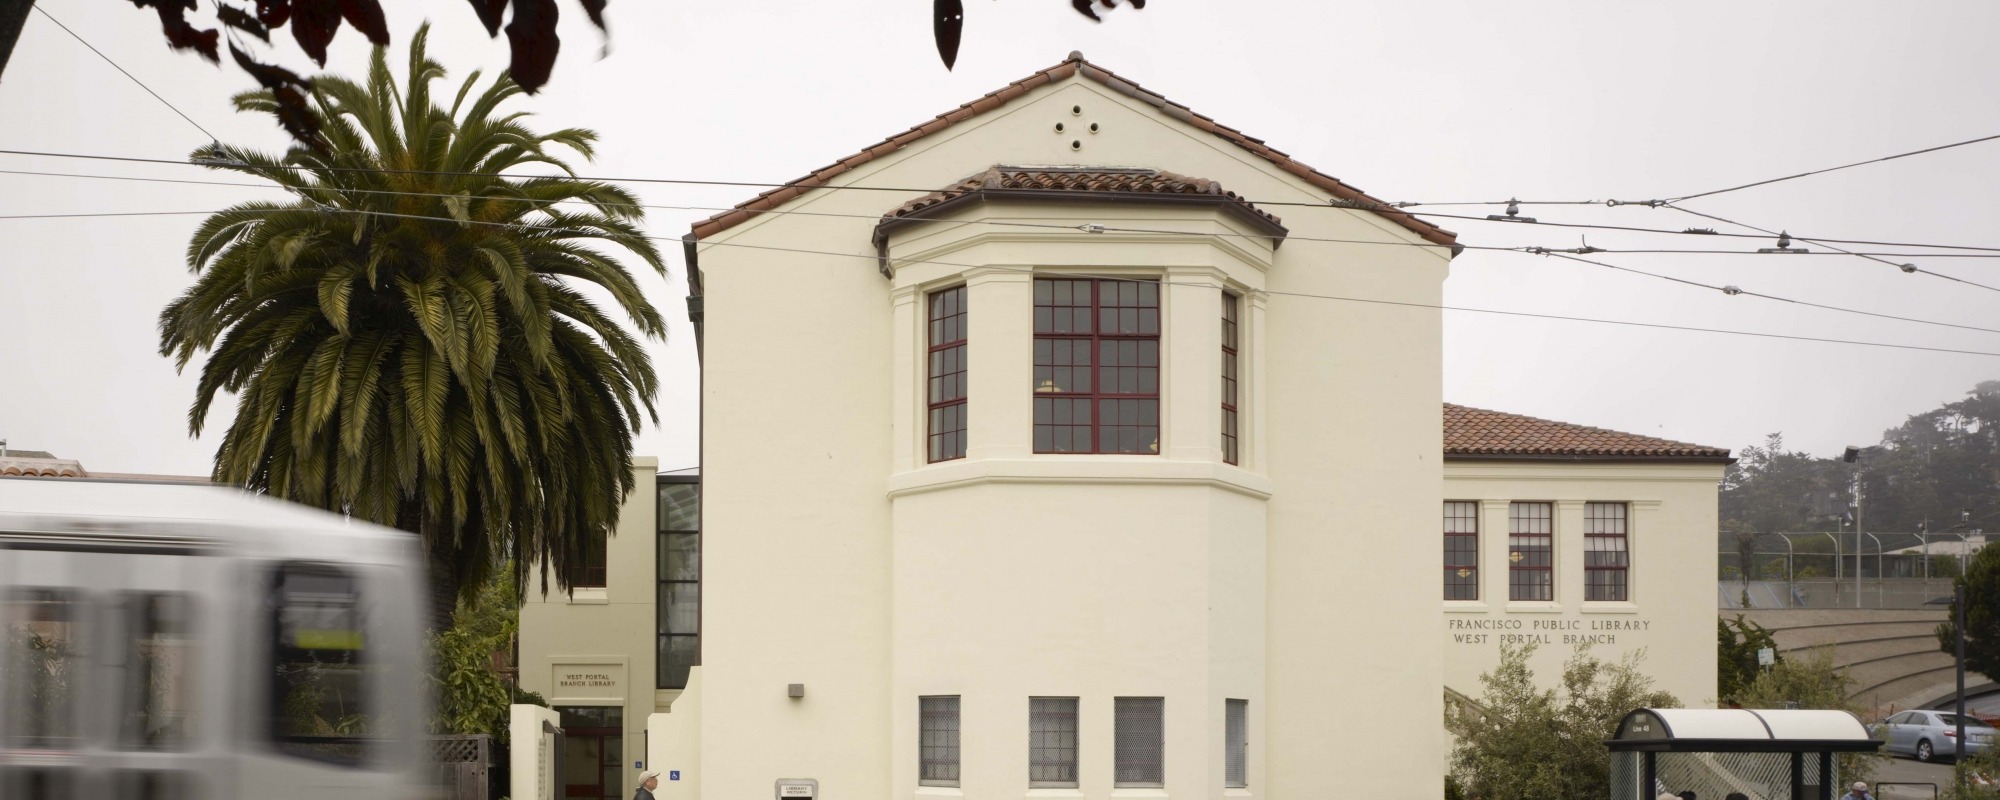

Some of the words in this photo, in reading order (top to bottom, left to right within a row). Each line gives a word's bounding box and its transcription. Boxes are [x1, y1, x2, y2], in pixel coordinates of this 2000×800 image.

[1449, 619, 1522, 630] FRANCISCO
[1533, 620, 1580, 630] PUBLIC
[1592, 620, 1650, 630] LIBRARY
[1454, 634, 1489, 644] WEST
[1500, 634, 1551, 644] PORTAL
[1563, 634, 1615, 644] BRANCH
